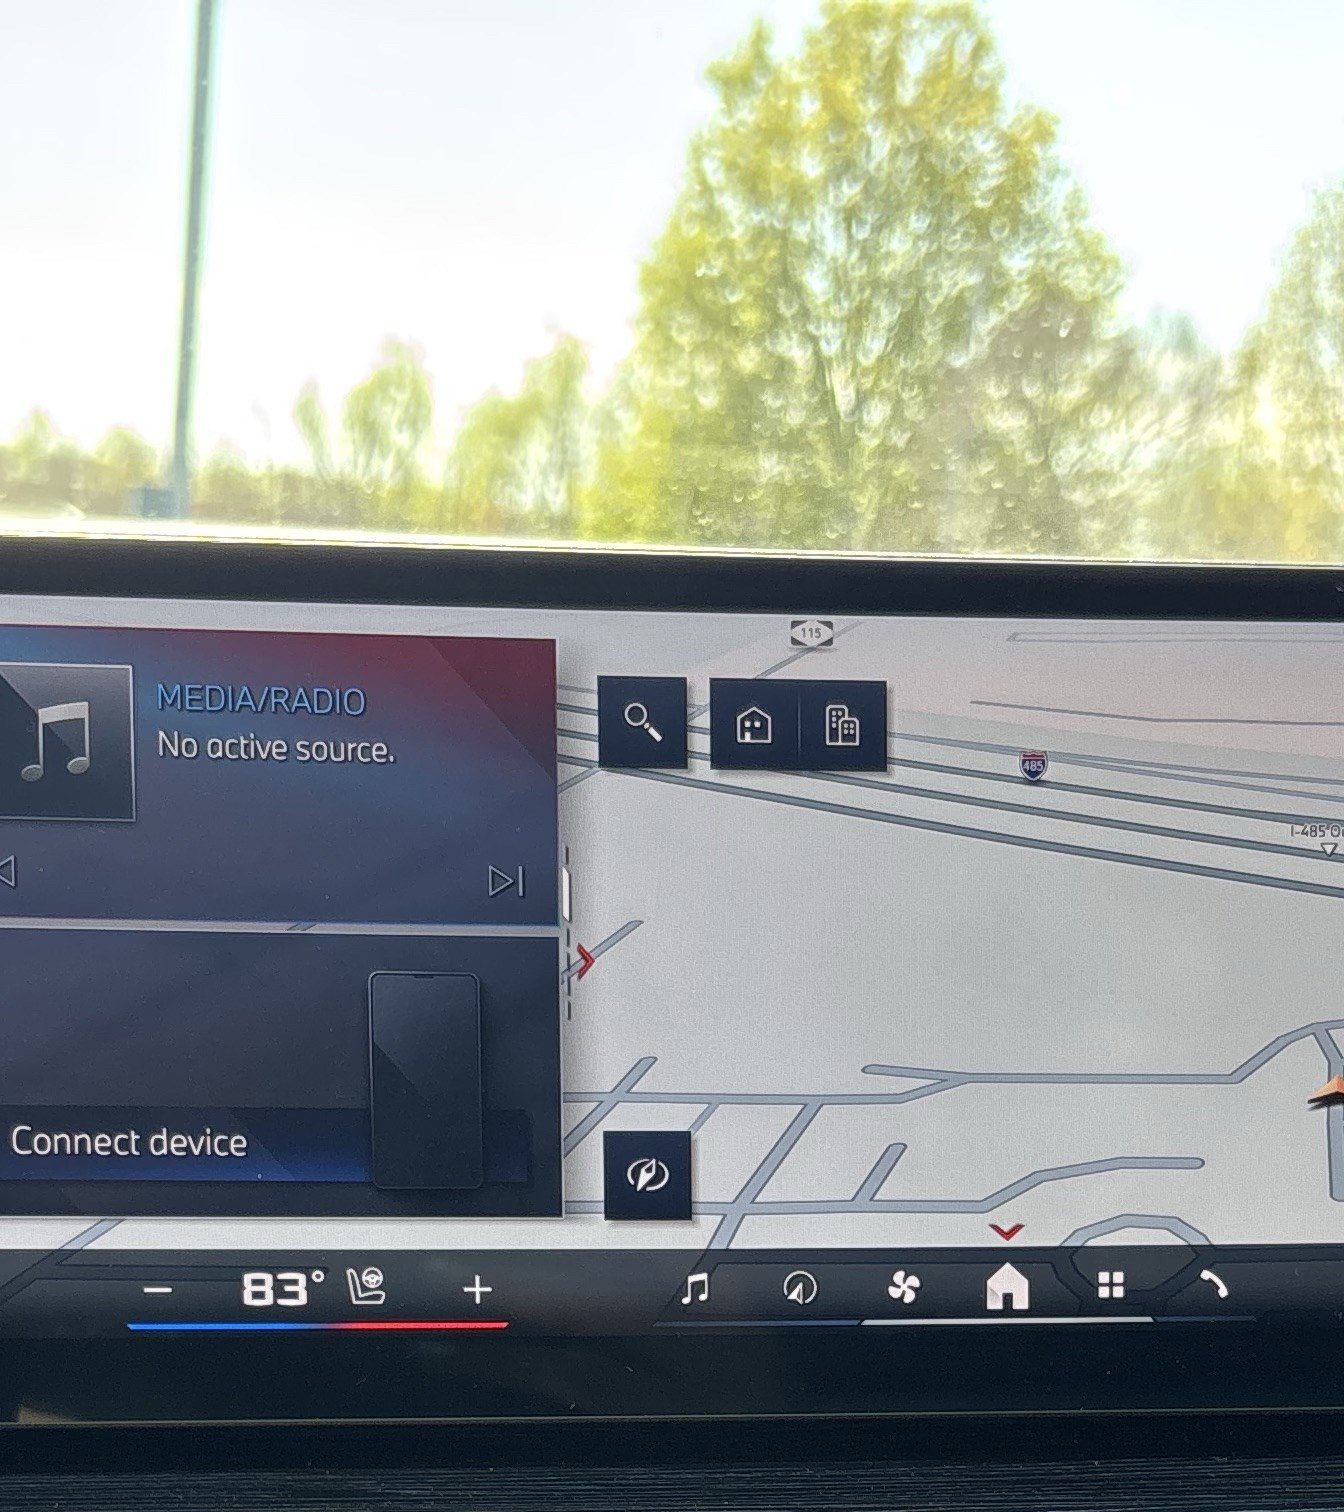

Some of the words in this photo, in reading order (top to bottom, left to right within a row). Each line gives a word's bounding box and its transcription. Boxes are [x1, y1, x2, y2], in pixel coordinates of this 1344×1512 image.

[801, 627, 822, 639] 115
[156, 683, 366, 716] MEDIA/RADIO
[158, 730, 198, 759] No
[207, 733, 288, 761] active
[296, 739, 395, 763] source.
[1023, 760, 1044, 772] 485
[1290, 824, 1326, 838] I-485
[11, 1125, 141, 1157] Connect
[149, 1126, 248, 1158] device
